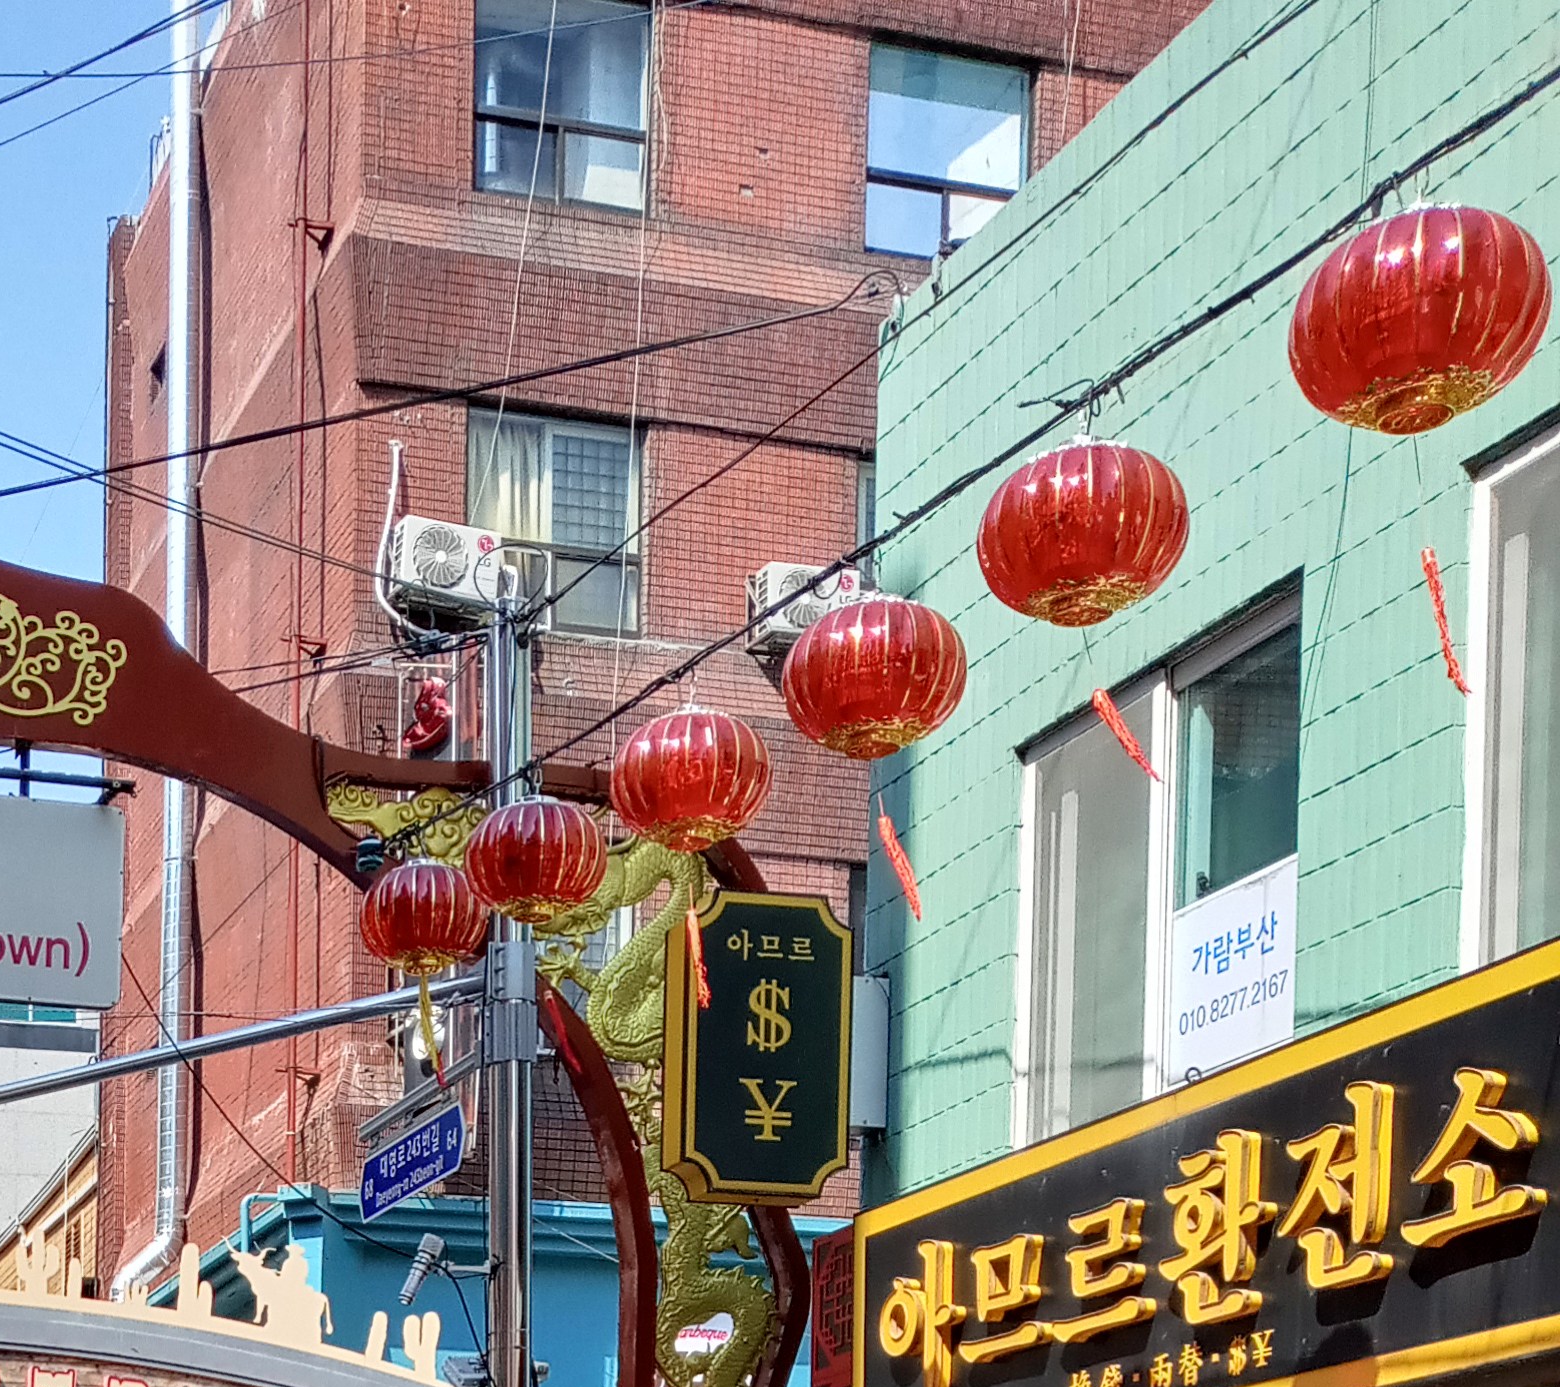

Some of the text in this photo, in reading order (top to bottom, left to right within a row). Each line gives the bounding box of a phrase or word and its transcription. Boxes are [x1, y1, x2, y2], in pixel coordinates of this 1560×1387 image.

[478, 556, 491, 567] LG
[726, 928, 816, 962] 아므르
[1190, 910, 1279, 979] 가람부산
[746, 978, 793, 1053] $
[1178, 968, 1289, 1037] 010.8277.2167
[446, 1127, 458, 1151] 64
[364, 1178, 374, 1200] 68
[677, 1324, 728, 1342] arbeque
